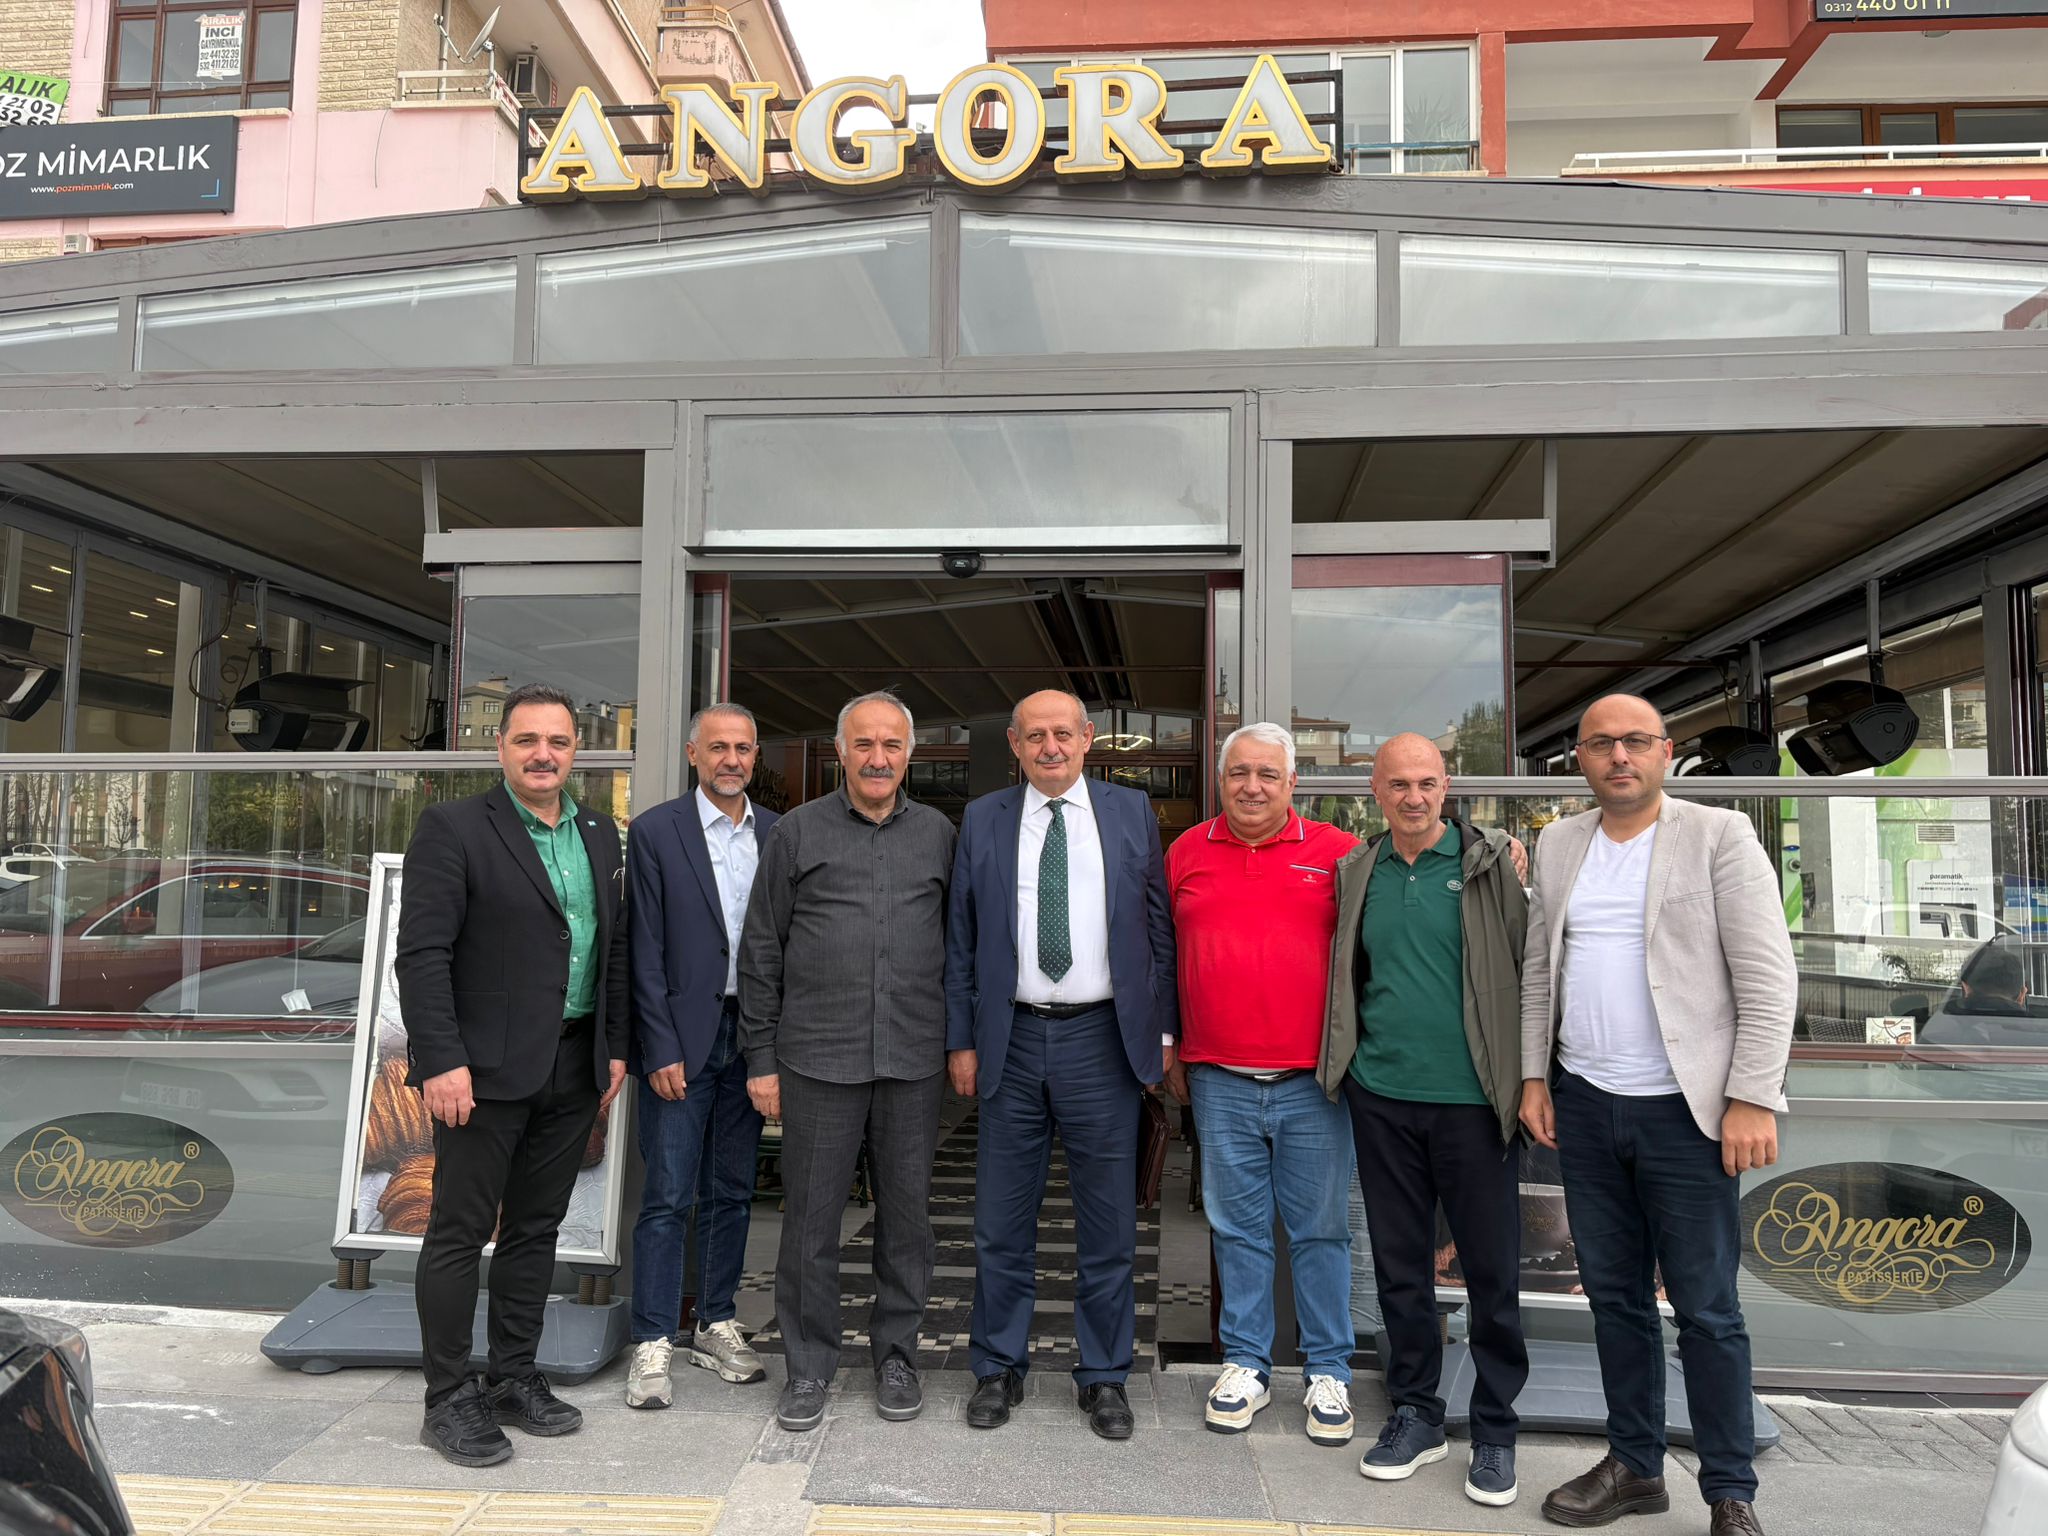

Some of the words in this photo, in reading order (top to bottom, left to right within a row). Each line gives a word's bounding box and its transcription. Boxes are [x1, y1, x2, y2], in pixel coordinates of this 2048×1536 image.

[1824, 3, 1853, 12] 0312
[1856, 0, 1896, 11] 440
[0, 75, 57, 98] ALIK
[519, 54, 1332, 196] ANGORA
[0, 152, 27, 178] Z
[37, 143, 211, 177] MİMARLIK
[1929, 873, 1963, 881] paramatik
[15, 1126, 202, 1206] Angora
[82, 1206, 144, 1219] PATISSERIE
[1753, 1182, 1990, 1272] Angora
[1847, 1271, 1924, 1284] PATISSERIE
